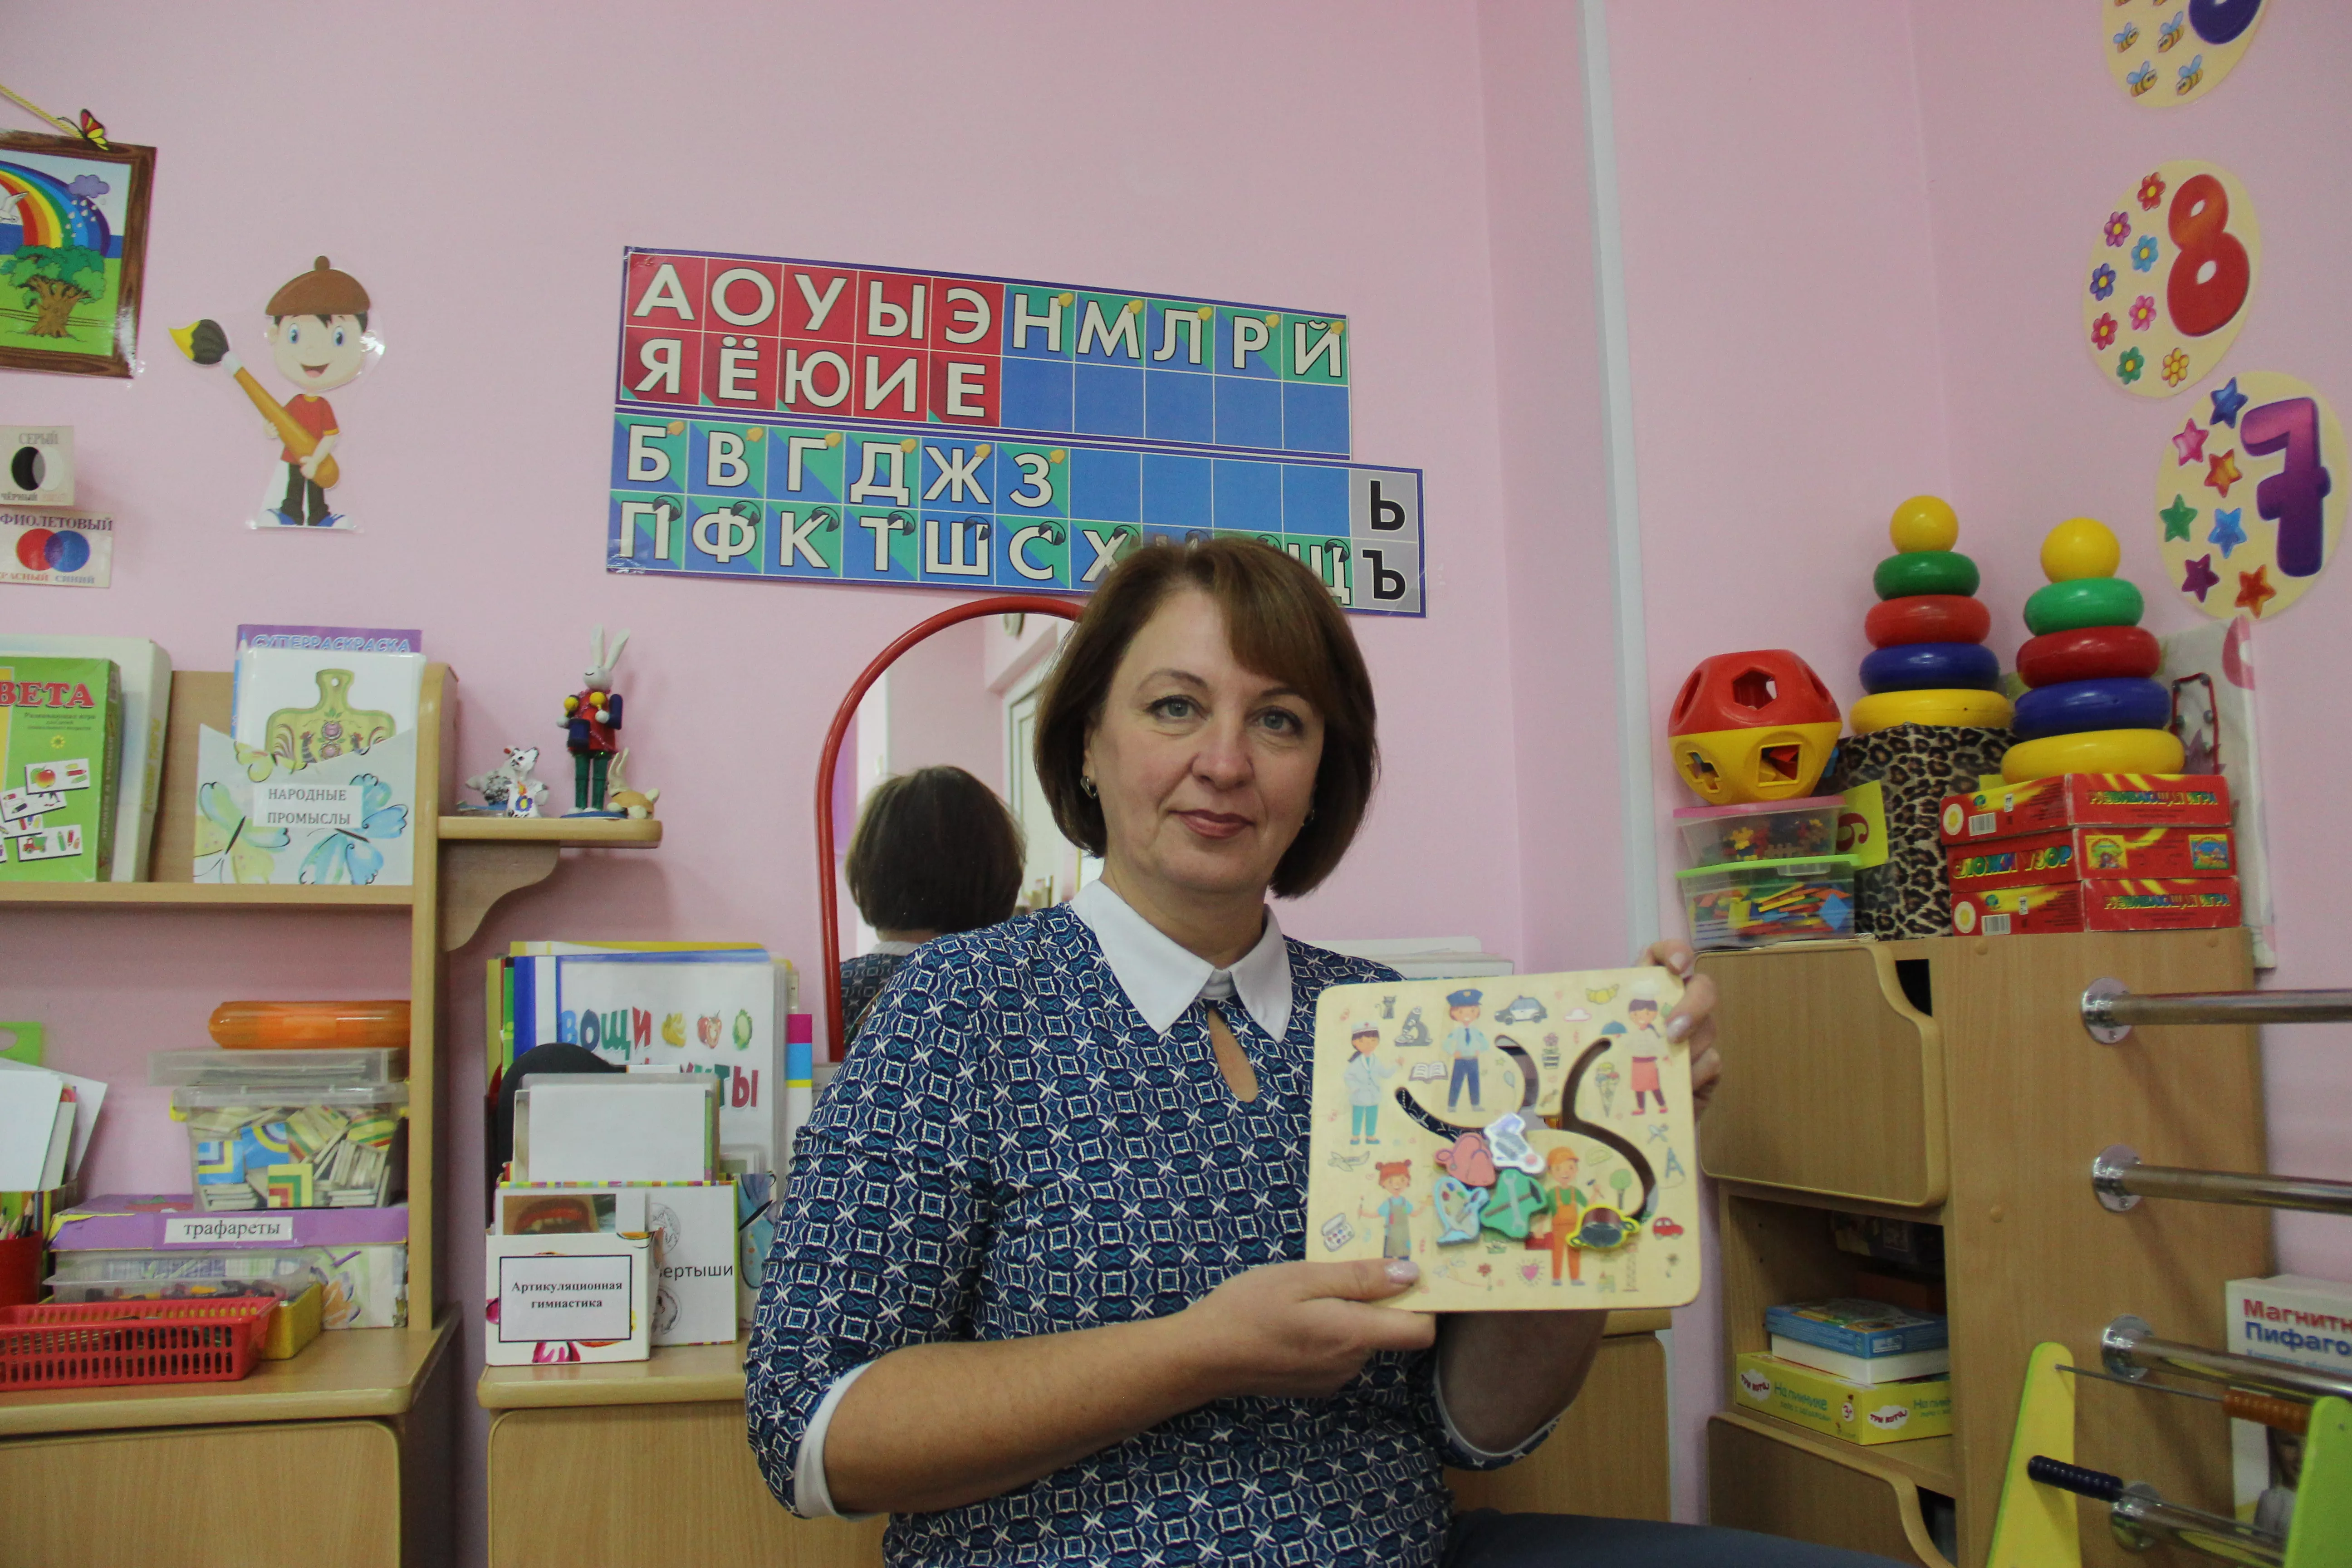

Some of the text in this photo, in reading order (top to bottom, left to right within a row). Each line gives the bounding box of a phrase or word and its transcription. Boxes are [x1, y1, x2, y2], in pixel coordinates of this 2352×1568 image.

[2167, 174, 2249, 337] 8
[633, 264, 1343, 377] А О У Ы Э Н М Л Р Й
[635, 336, 985, 417] Я Ё Ю И Е
[19, 430, 59, 445] СЕРЫЙ
[627, 425, 1405, 532] Б В Г Д Ж З Ь
[2240, 397, 2330, 577] 7
[0, 514, 113, 531] ФИОЛЕТОВЫЙ
[620, 502, 671, 560] П
[691, 507, 756, 563] Ф
[779, 511, 829, 568] К
[859, 516, 904, 571] Т
[925, 520, 990, 576] Ш
[1008, 526, 1054, 580] С
[1081, 529, 1128, 581] Х
[1362, 550, 1406, 600] Ъ
[0, 572, 95, 584] РАСНЫЙ СИНИЙ
[251, 634, 411, 652] СУПЕРРАСКРАСКА
[0, 681, 95, 708] ВЕТА
[269, 788, 347, 802] НАРОДНЫЕ
[268, 812, 351, 824] ПРОМЫСЛЫ
[1952, 846, 2073, 879] СЛОЖИ УЗОР
[183, 1220, 281, 1239] трафареты
[659, 1265, 733, 1281] ертыши
[511, 1282, 622, 1294] Артикуляционная
[531, 1299, 603, 1308] гимнастика
[2245, 1321, 2352, 1357] Пифаго
